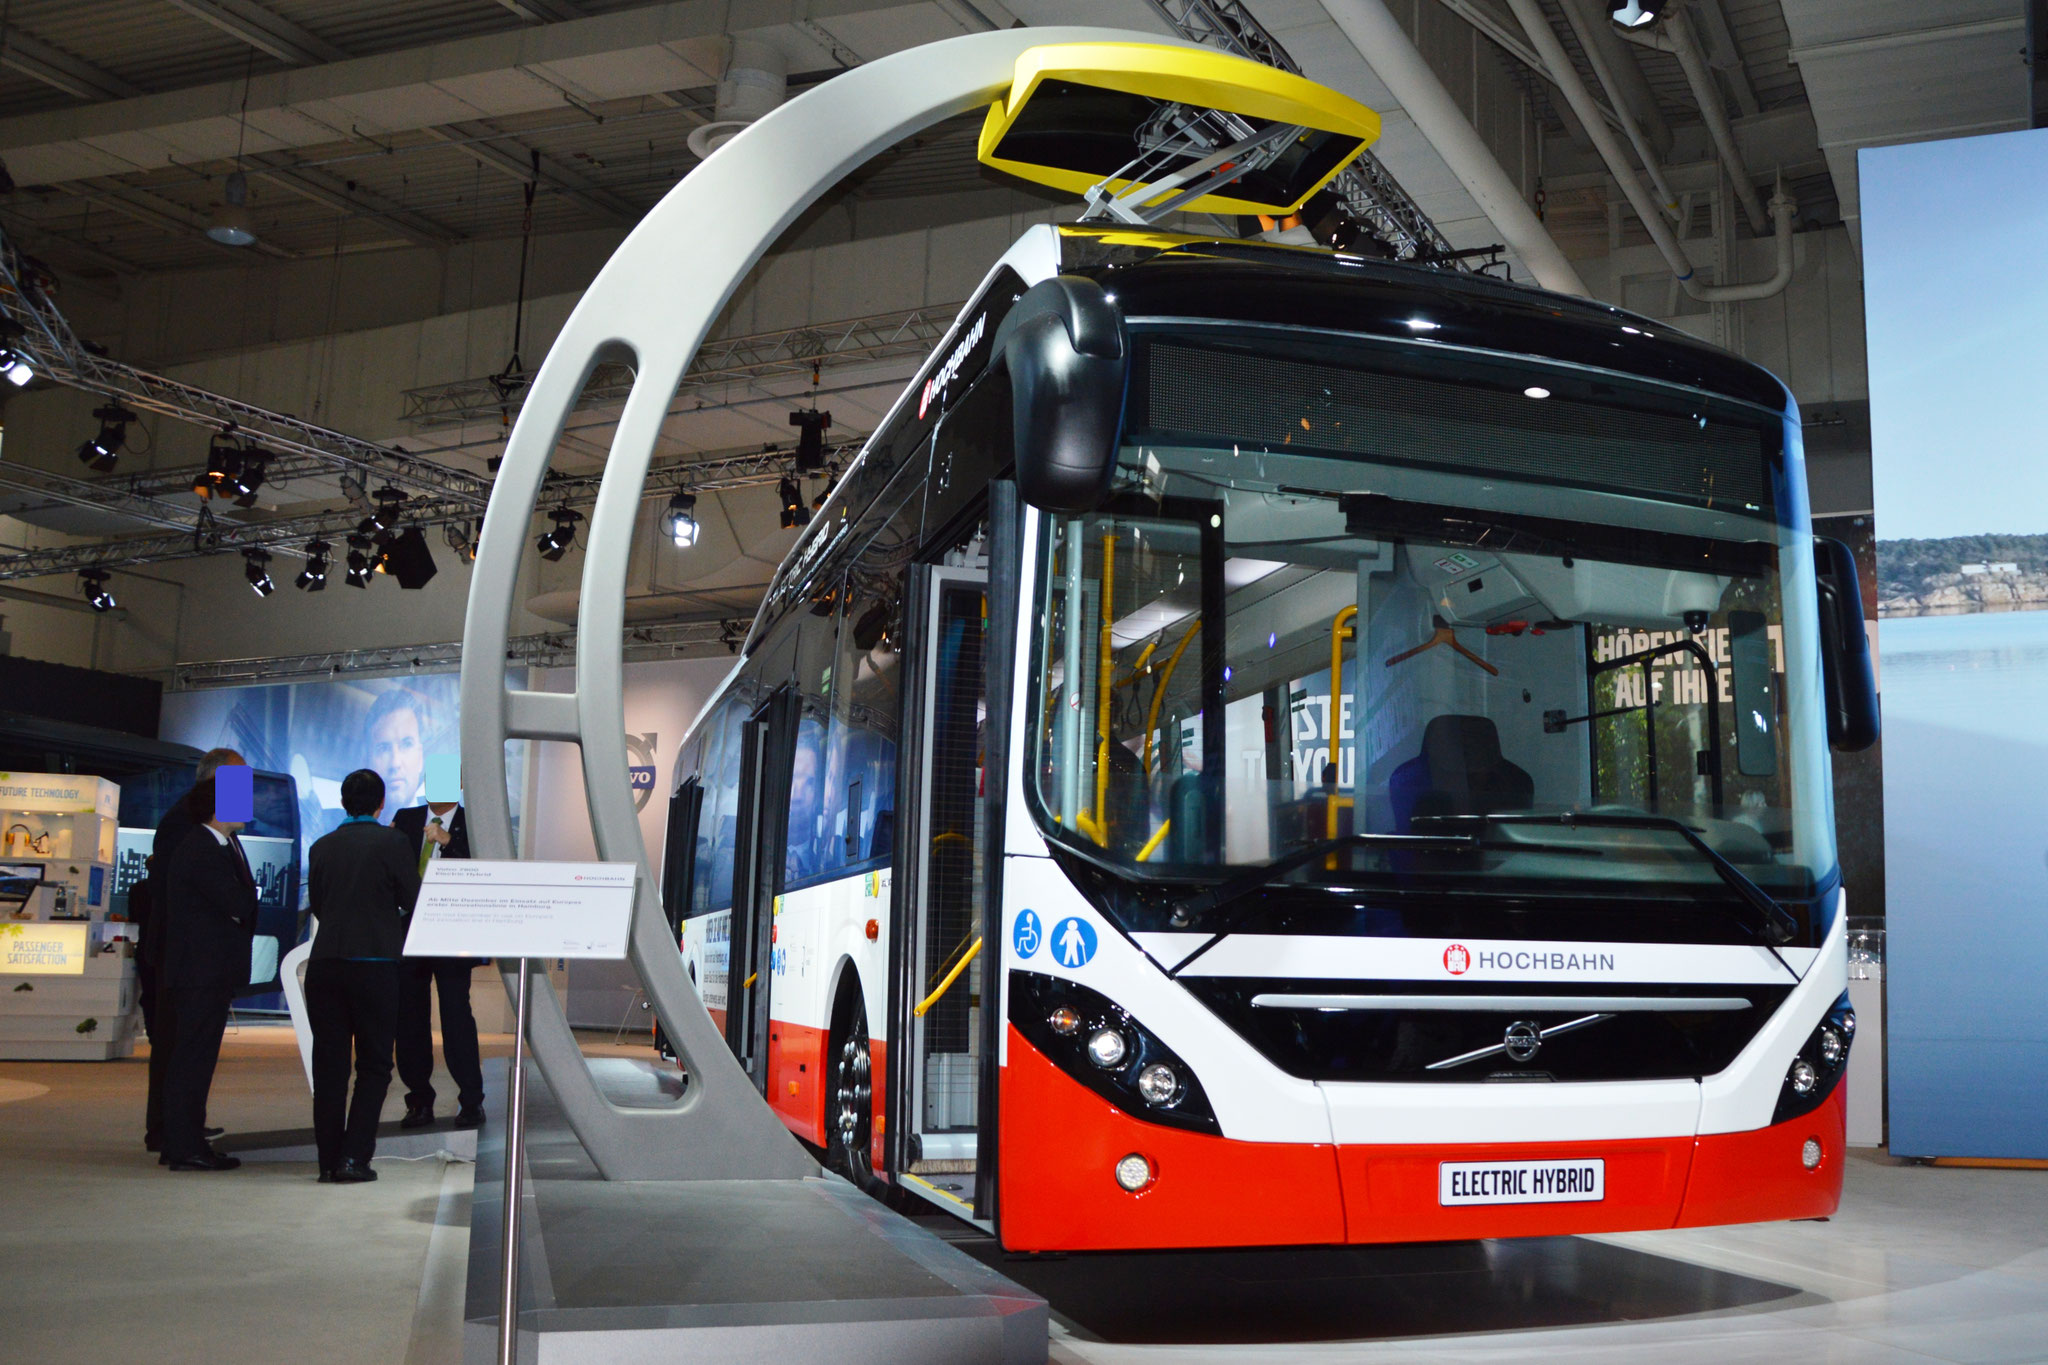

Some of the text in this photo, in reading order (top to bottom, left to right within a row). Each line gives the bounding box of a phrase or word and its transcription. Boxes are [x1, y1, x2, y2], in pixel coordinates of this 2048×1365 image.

[928, 310, 987, 404] HOCHBAHN
[1597, 628, 1684, 668] HÖREN
[1614, 671, 1665, 708] AUF
[0, 785, 80, 800] FUTURE TECHNOLOGY
[13, 940, 65, 952] PASSENGER
[7, 953, 67, 965] SATISFACTION
[1478, 951, 1615, 971] HOCHBAHN
[1451, 1167, 1595, 1197] ELECTRIC HYBRID
